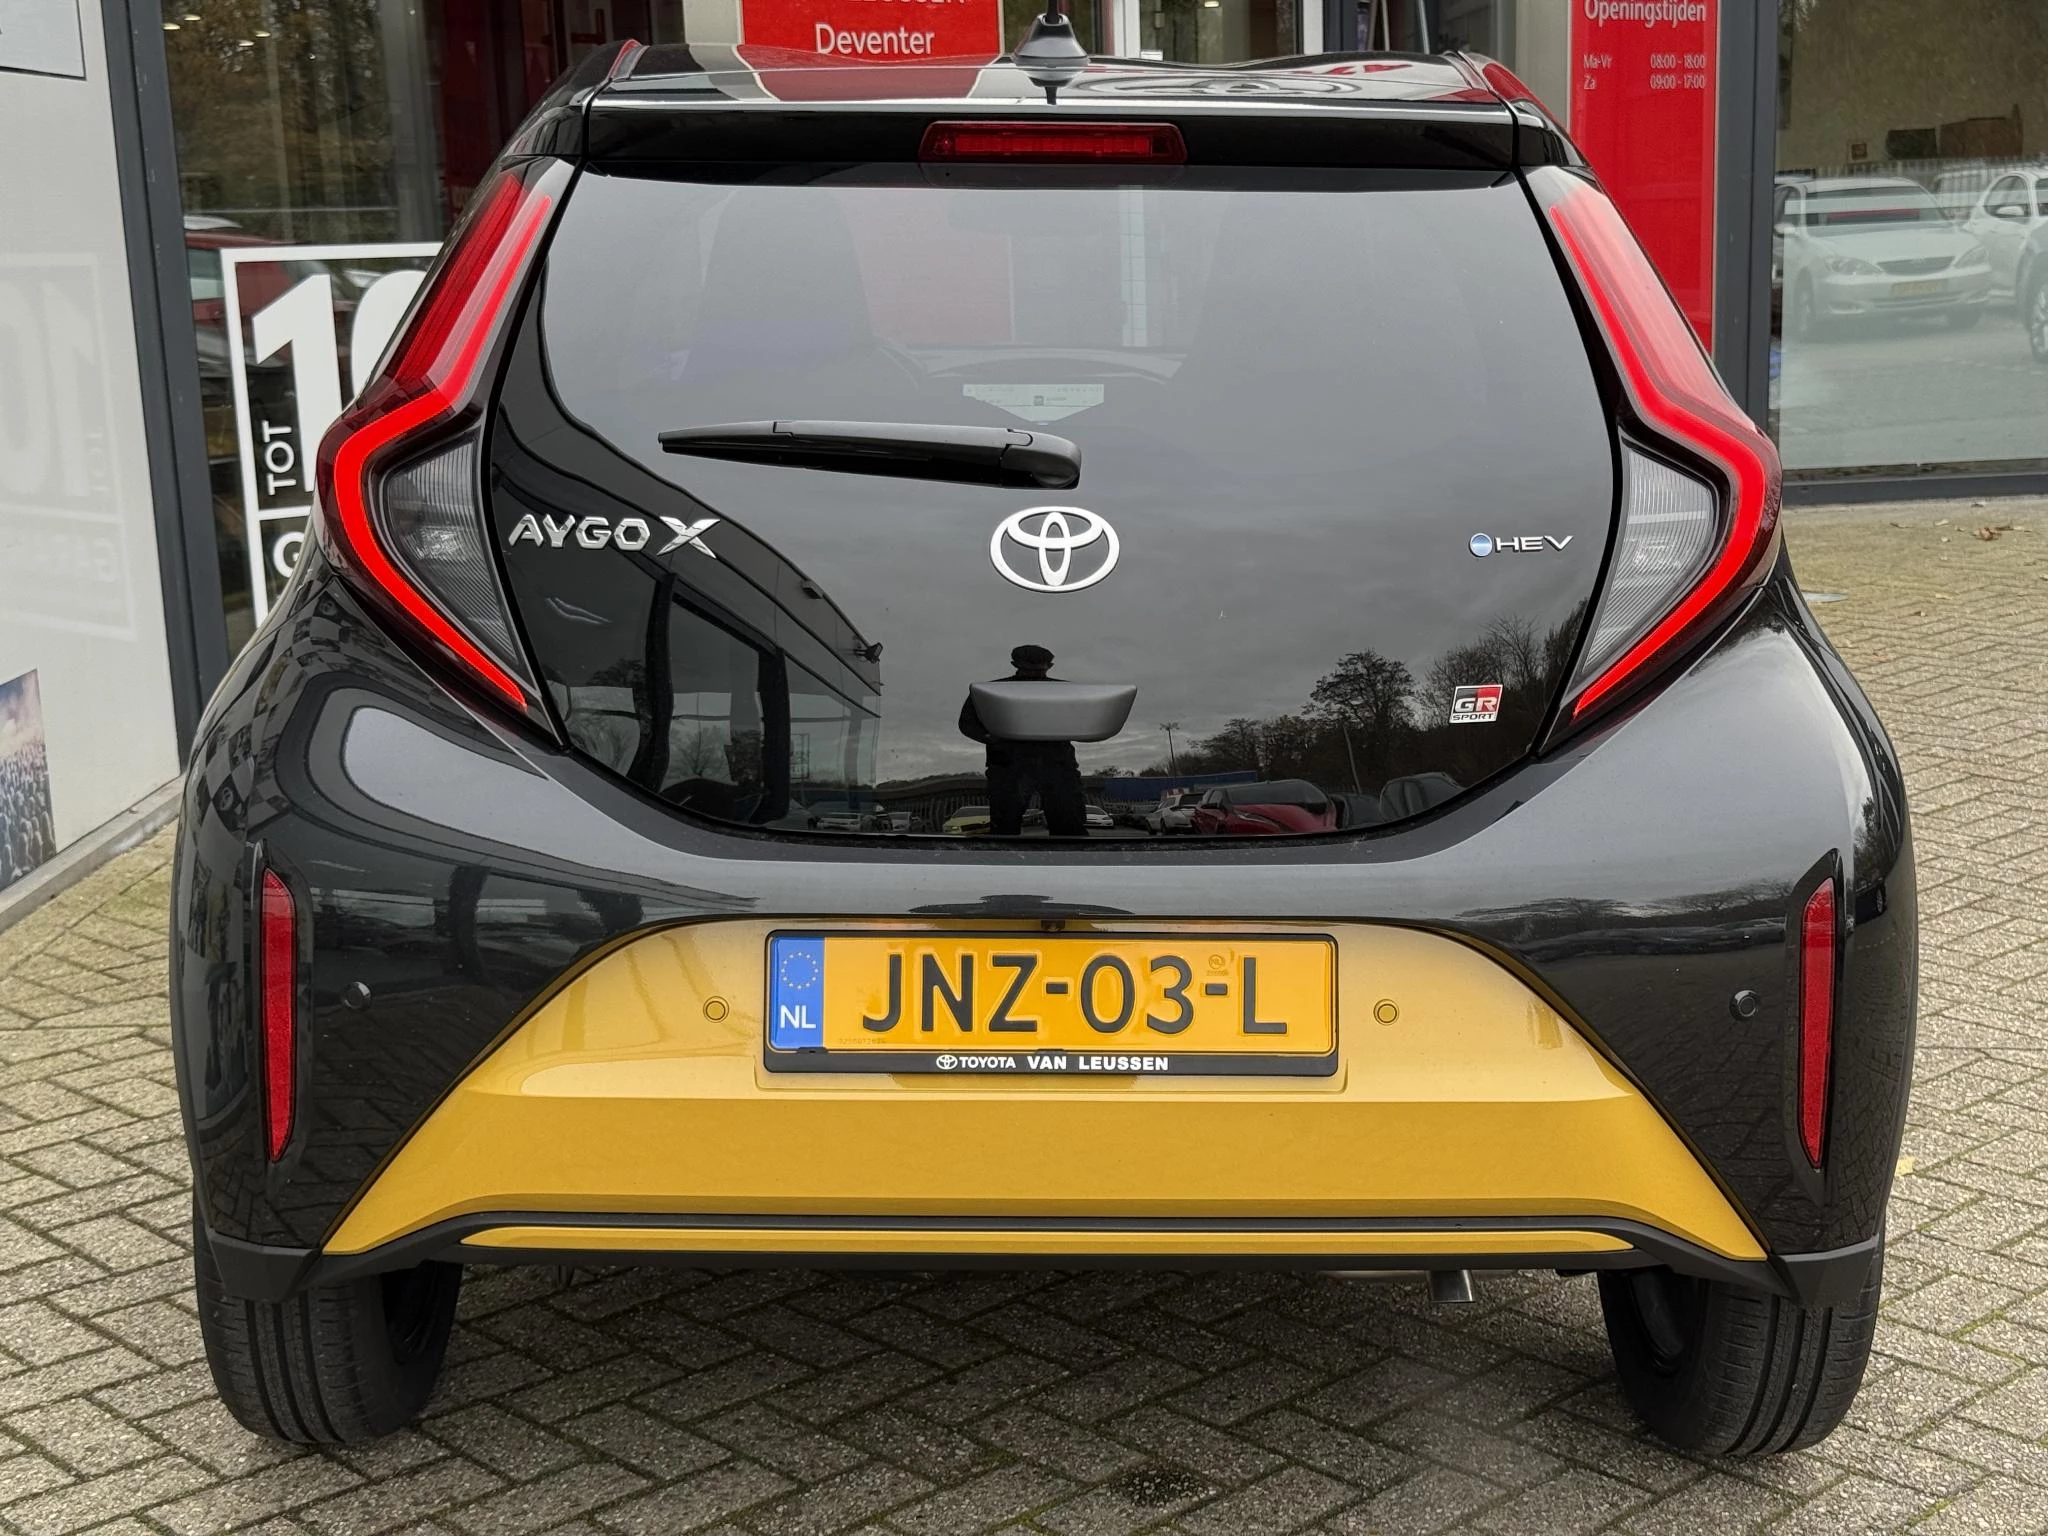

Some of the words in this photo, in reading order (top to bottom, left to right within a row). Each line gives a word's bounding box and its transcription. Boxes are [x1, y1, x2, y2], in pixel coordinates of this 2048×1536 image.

[1583, 0, 1706, 28] Openingstijden
[815, 22, 935, 54] Deventer
[1583, 54, 1612, 69] Ma-Vr
[1650, 54, 1676, 69] 08:00
[1683, 54, 1706, 69] 18:00
[1583, 74, 1596, 90] Za
[1650, 75, 1676, 89] 09:00
[1683, 75, 1706, 89] 17:00
[262, 420, 297, 496] TOT
[508, 513, 651, 551] AYGO
[656, 515, 721, 559] X
[1494, 535, 1574, 552] HEV
[1454, 697, 1498, 713] GR
[1452, 713, 1495, 721] SPORT
[862, 953, 1288, 1035] JNZ-03-L
[780, 1004, 817, 1029] NL
[959, 1056, 1017, 1070] TOYOTA
[1027, 1056, 1067, 1070] VAN
[1078, 1056, 1169, 1071] LEUSSEN
